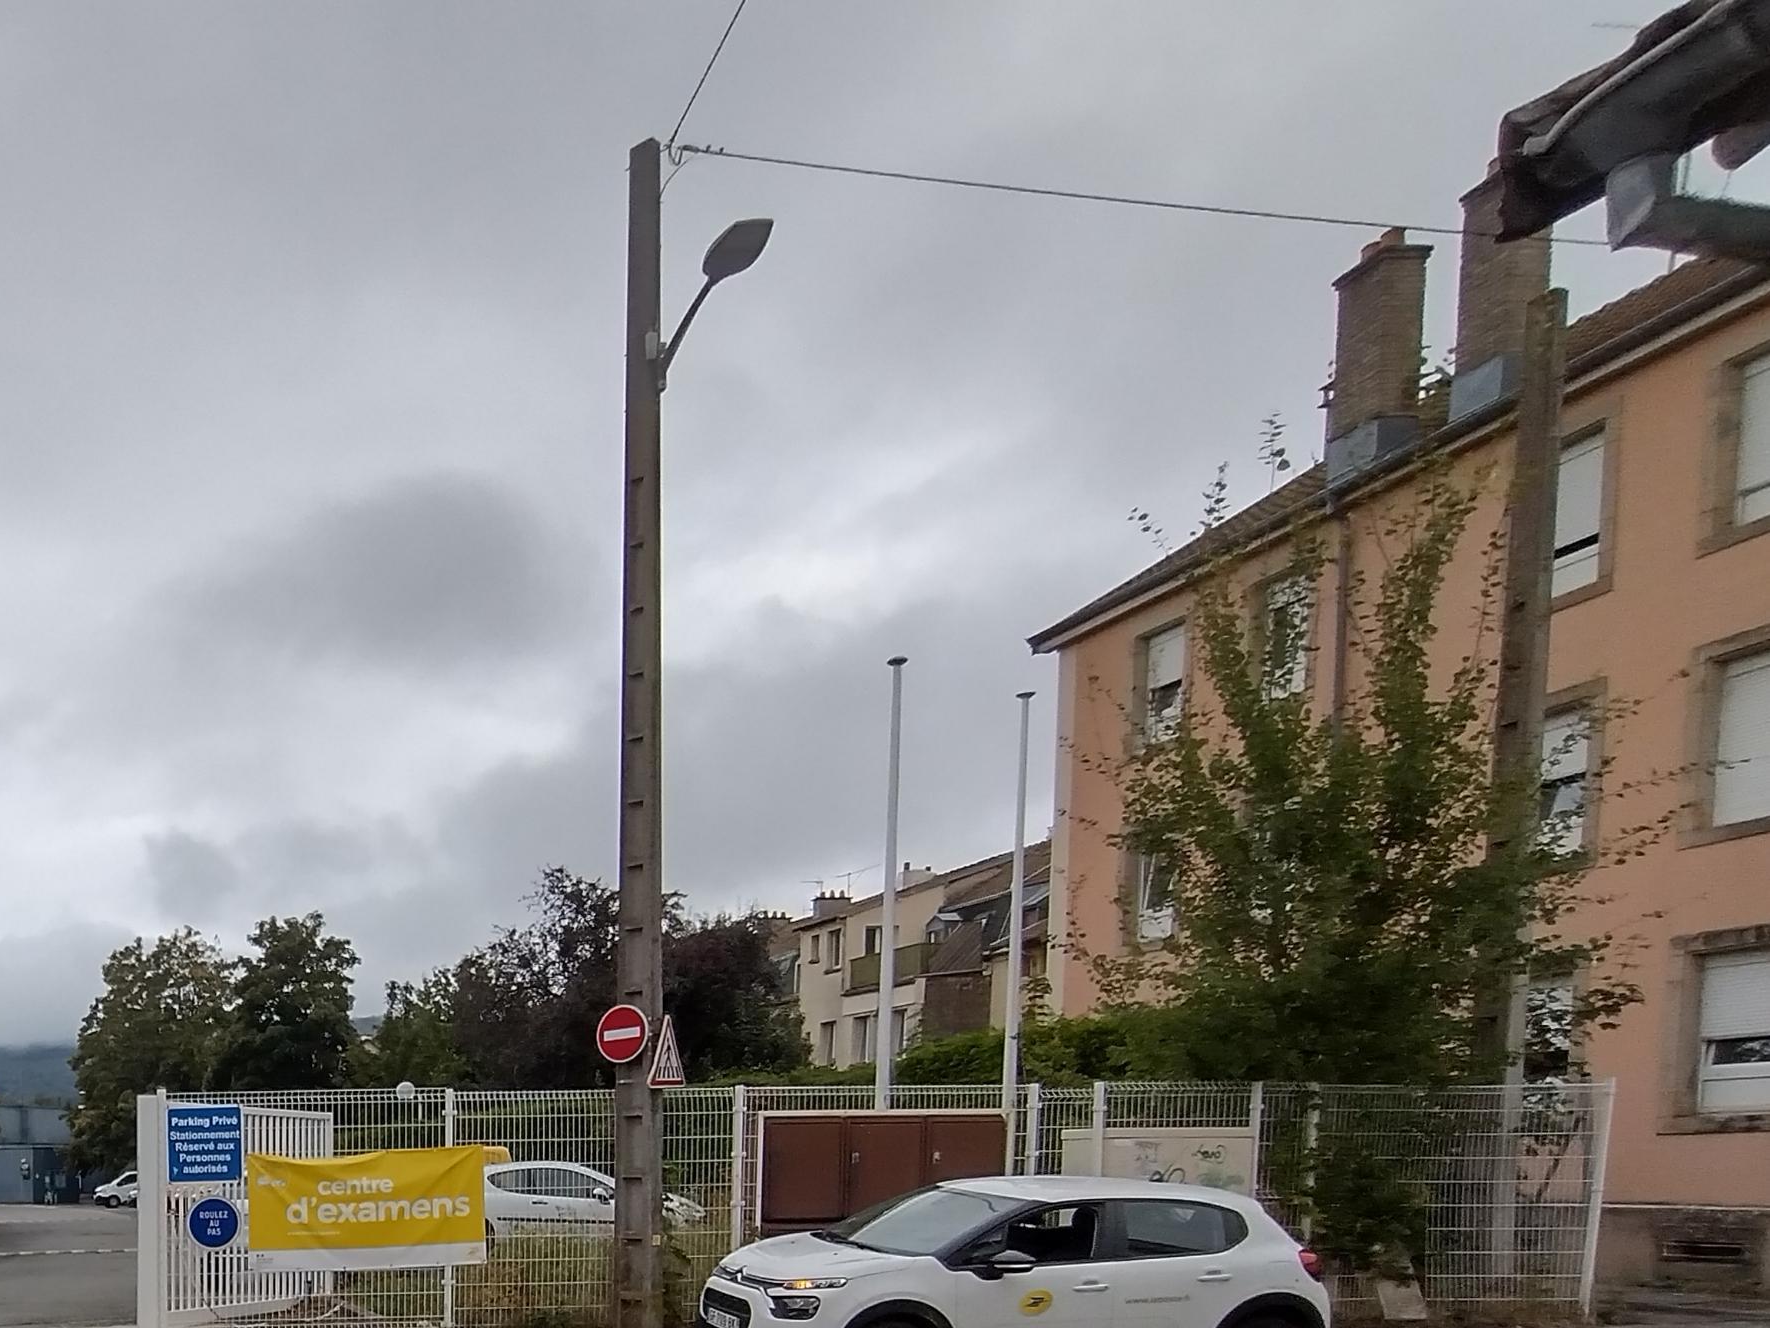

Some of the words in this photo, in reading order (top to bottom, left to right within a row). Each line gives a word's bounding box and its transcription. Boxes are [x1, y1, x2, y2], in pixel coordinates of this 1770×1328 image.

[171, 1116, 210, 1128] Parking
[212, 1115, 238, 1126] Privé
[170, 1130, 240, 1140] Stationnement
[175, 1141, 215, 1152] Réservé
[217, 1142, 235, 1150] aux
[179, 1153, 231, 1163] Personnes
[183, 1163, 228, 1174] autorisés
[317, 1176, 394, 1196] centre
[199, 1210, 229, 1219] ROULEZ
[285, 1196, 471, 1225] d'examens
[209, 1219, 220, 1227] AU
[207, 1228, 221, 1236] PAS
